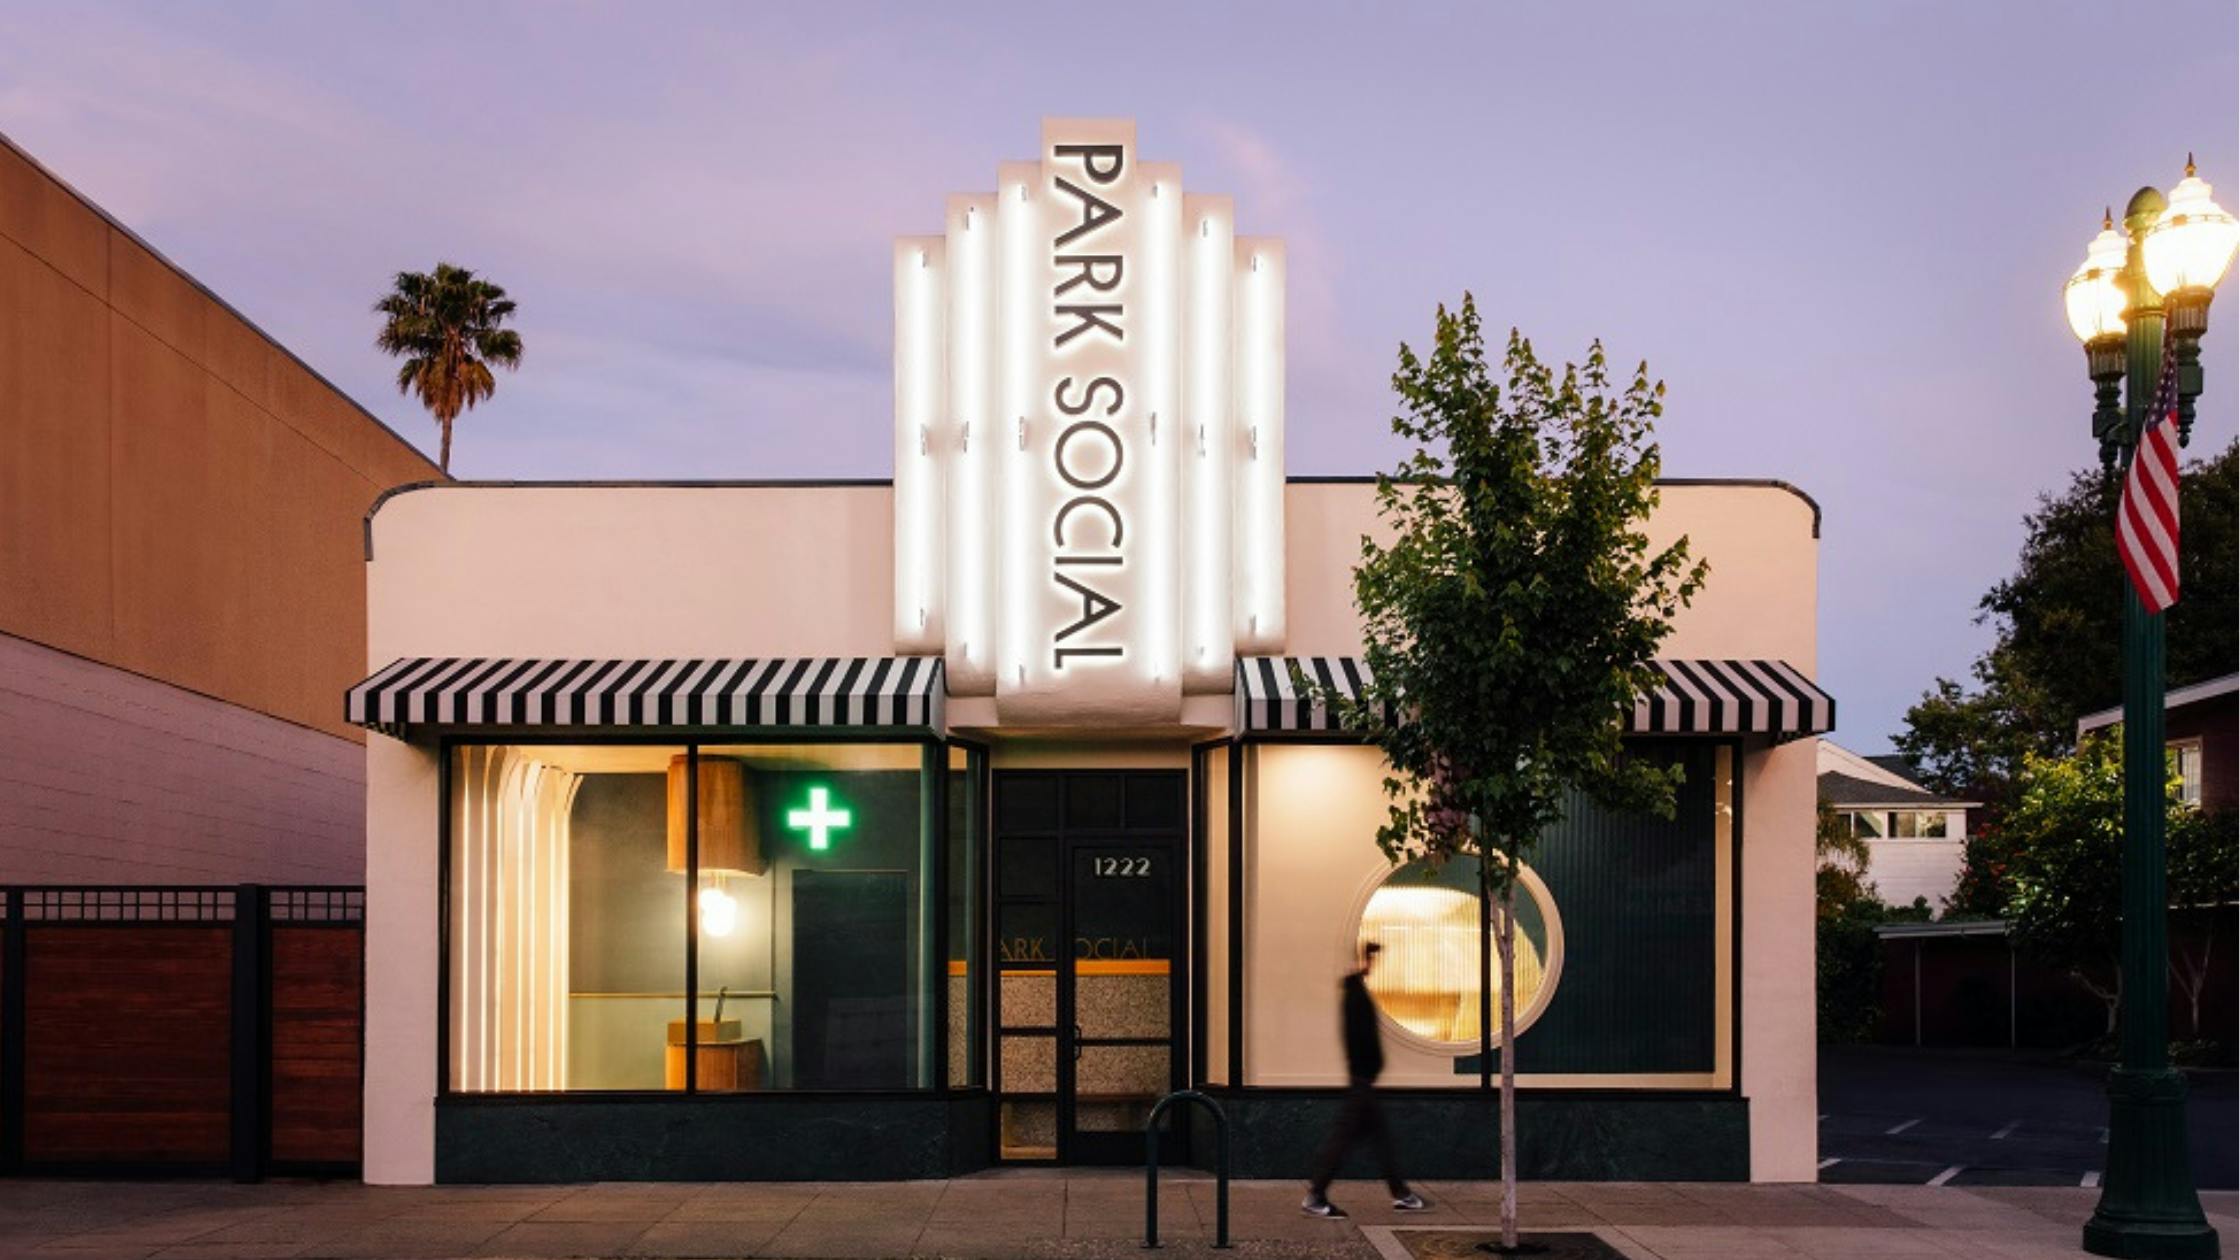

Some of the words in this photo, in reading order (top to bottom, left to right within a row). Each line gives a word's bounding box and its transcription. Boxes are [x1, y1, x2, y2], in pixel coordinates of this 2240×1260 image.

[1054, 144, 1124, 346] PARK
[1054, 376, 1124, 669] SOCIAL
[1094, 856, 1151, 876] 1222
[1000, 937, 1046, 960] ARK
[1074, 937, 1147, 959] OCIAL
